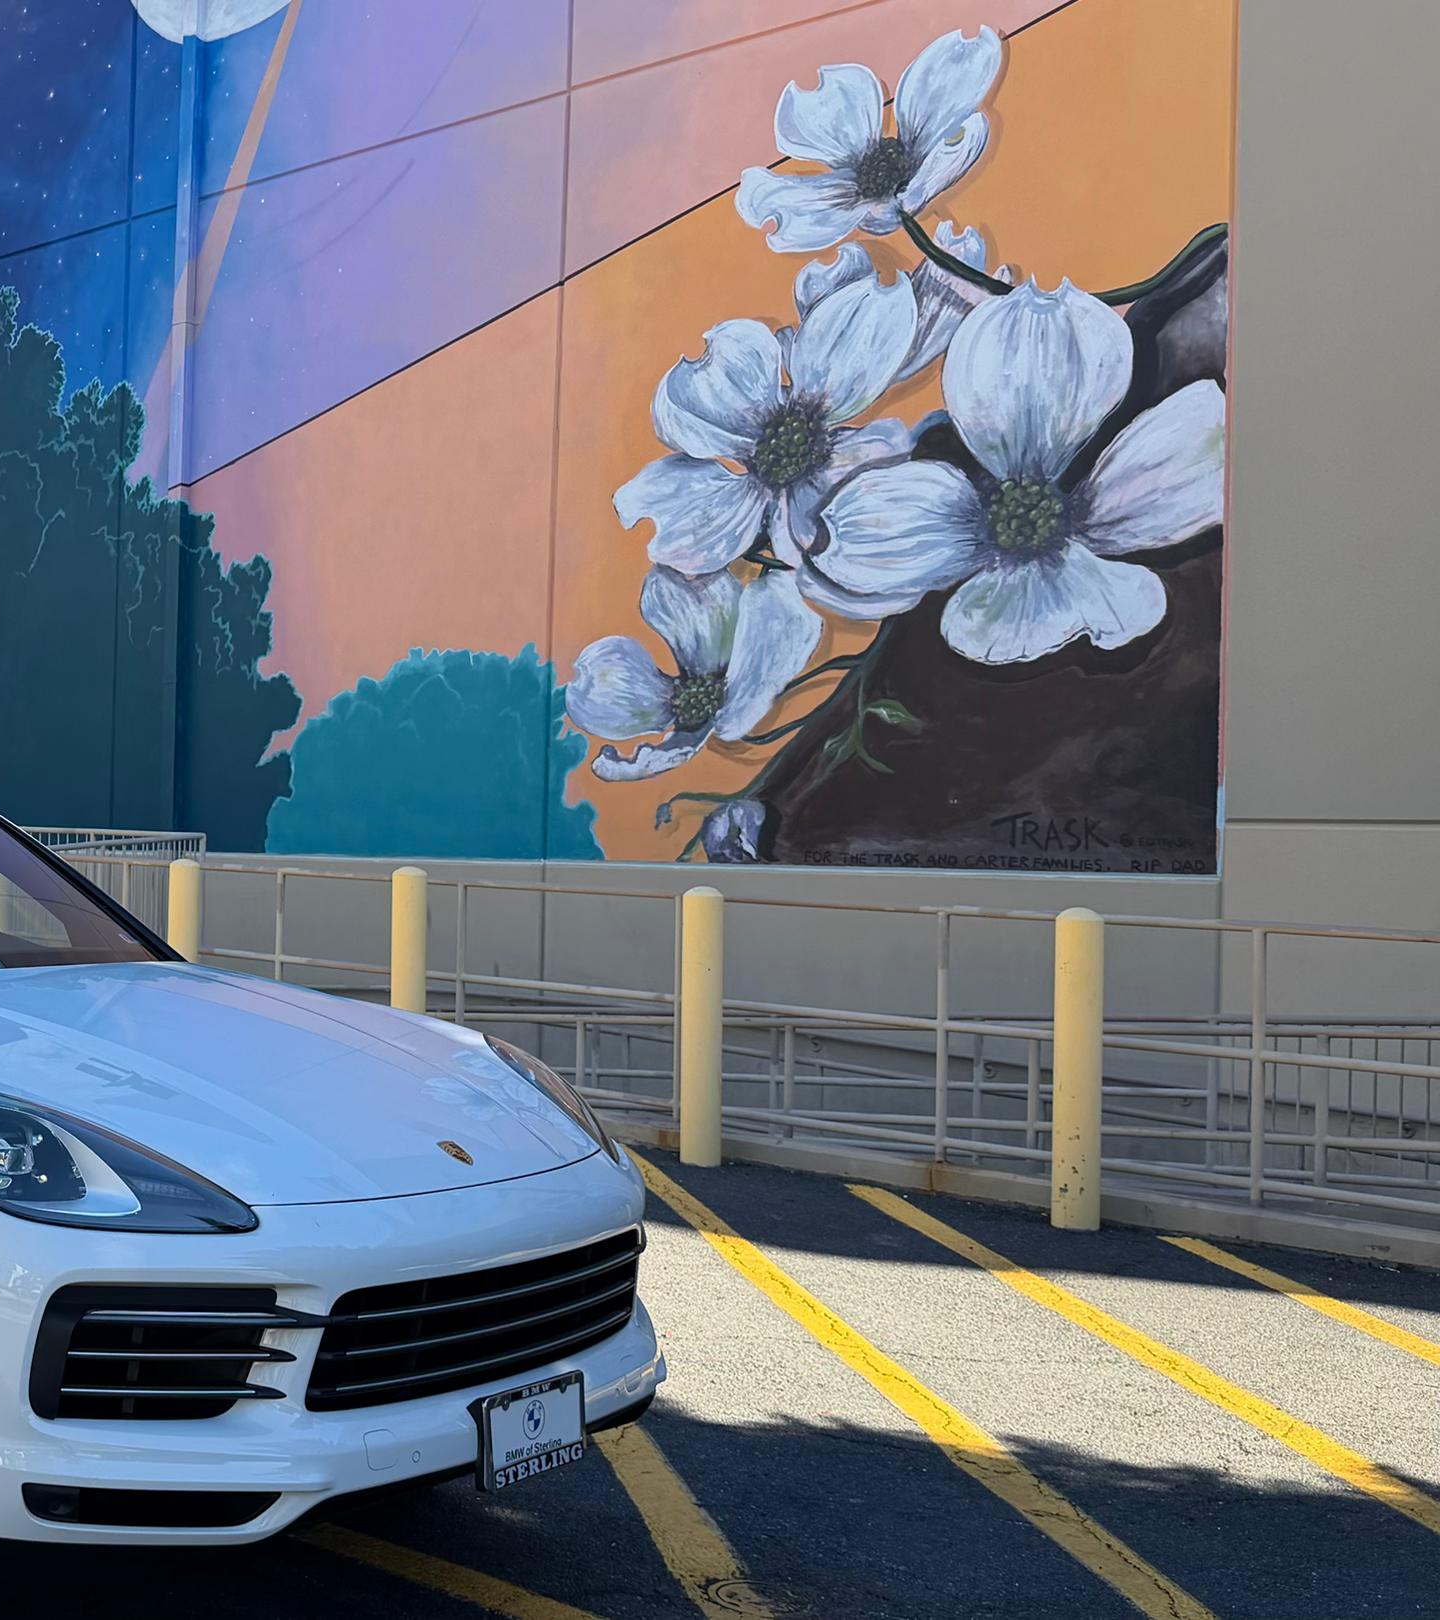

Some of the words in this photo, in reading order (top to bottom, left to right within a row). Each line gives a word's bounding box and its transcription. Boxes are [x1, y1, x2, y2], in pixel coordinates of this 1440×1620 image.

[990, 811, 1109, 851] TRASK
[804, 850, 832, 864] FOR
[839, 852, 867, 865] THE
[873, 852, 920, 866] TRASK
[927, 854, 958, 866] AND
[964, 854, 1029, 869] CARTER
[1130, 860, 1160, 873] RIP
[1171, 860, 1206, 873] DAD
[521, 1382, 551, 1398] BMW
[505, 1446, 525, 1462] BMW
[525, 1443, 533, 1456] of
[534, 1438, 562, 1454] Sterling
[495, 1443, 583, 1489] STERLING
